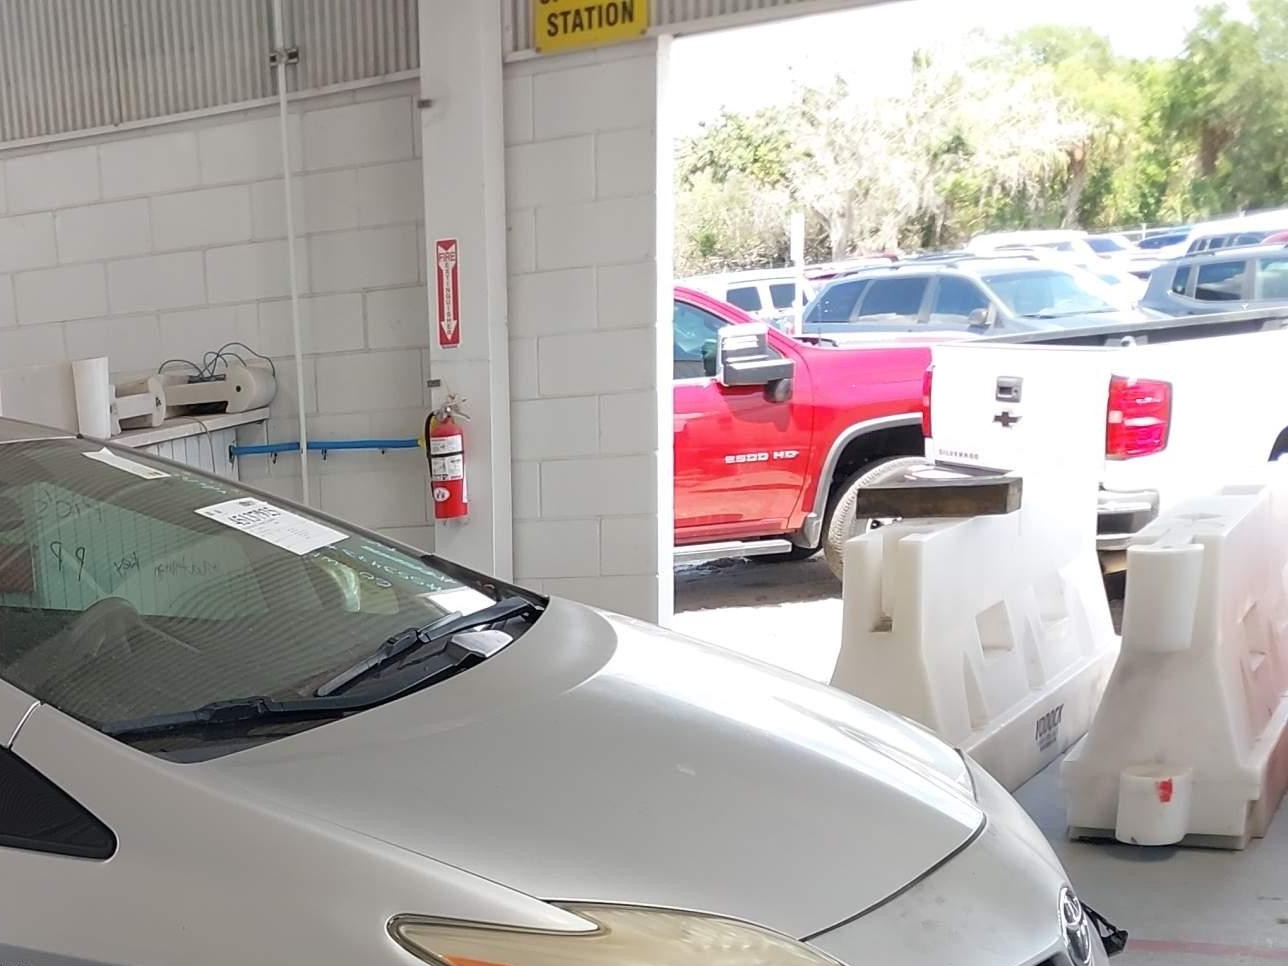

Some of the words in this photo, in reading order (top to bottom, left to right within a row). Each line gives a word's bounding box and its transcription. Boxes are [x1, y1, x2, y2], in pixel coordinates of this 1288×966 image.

[546, 0, 634, 37] STATION
[439, 251, 456, 262] FIRE
[444, 261, 452, 335] EXTINGUISHER
